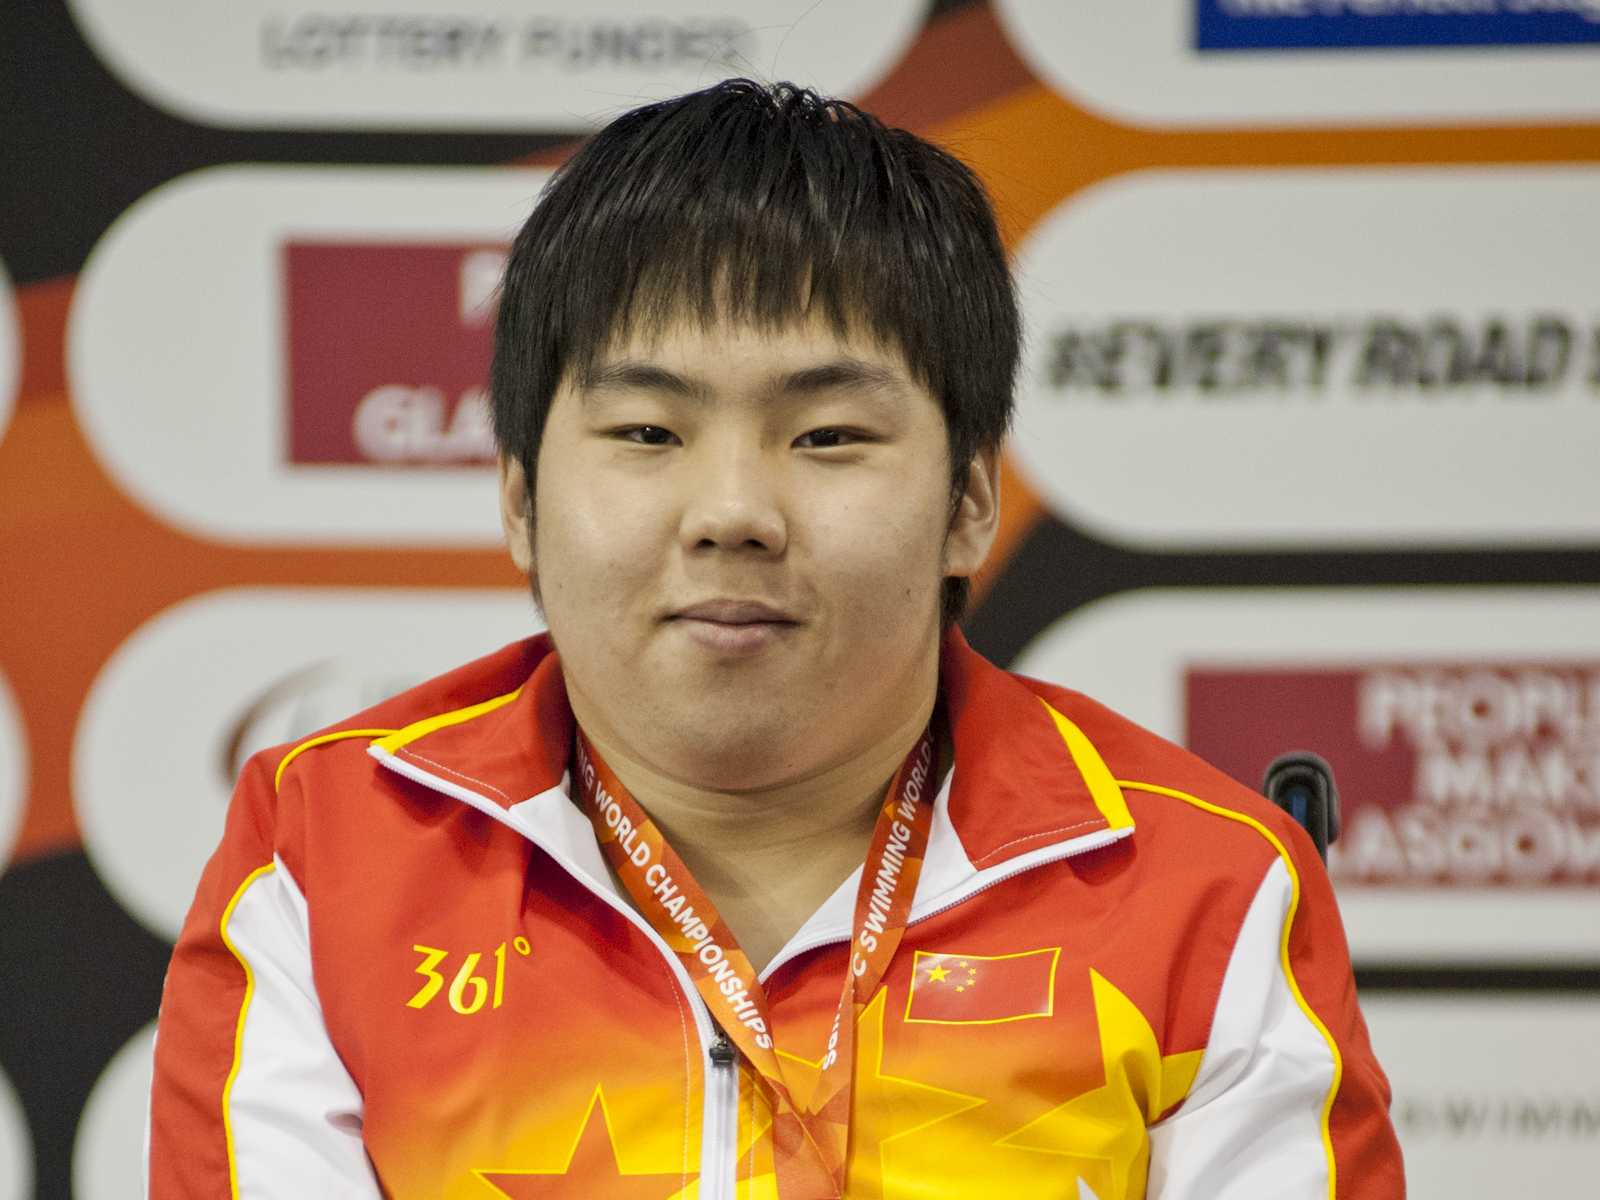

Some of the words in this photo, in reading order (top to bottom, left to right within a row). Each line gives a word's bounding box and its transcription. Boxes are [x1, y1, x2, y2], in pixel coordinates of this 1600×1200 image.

[261, 17, 500, 67] LOTTERY
[1356, 312, 1574, 388] ROAD
[595, 780, 650, 867] WORLD
[645, 864, 774, 1050] CHAMPIONSHIPS
[860, 821, 911, 953] SWIMMING
[898, 741, 931, 822] WORLD
